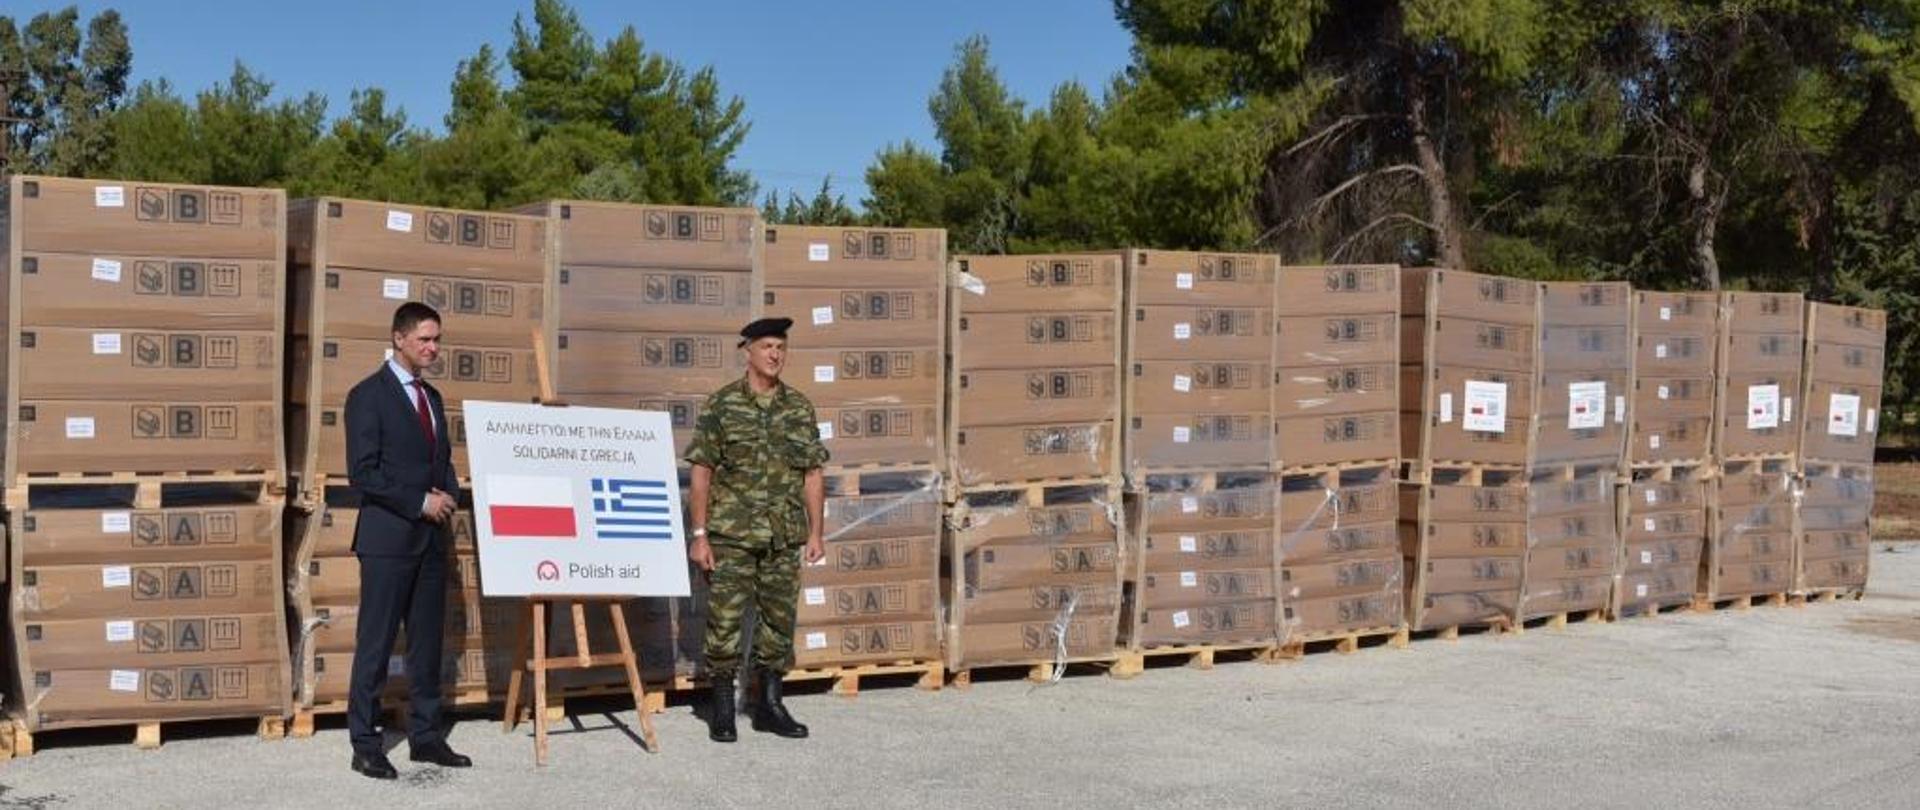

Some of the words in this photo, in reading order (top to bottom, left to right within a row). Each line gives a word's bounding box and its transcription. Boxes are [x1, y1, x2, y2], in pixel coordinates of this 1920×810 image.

[180, 194, 199, 218] B
[463, 220, 479, 242] B
[678, 216, 691, 236] B
[872, 236, 885, 255] B
[179, 267, 196, 291] B
[1054, 264, 1065, 282] B
[1222, 261, 1231, 278] B
[460, 287, 476, 308] B
[677, 279, 690, 299] B
[871, 296, 884, 314] B
[1054, 321, 1065, 338] B
[1221, 314, 1230, 331] B
[176, 339, 194, 362] B
[675, 342, 688, 362] B
[459, 355, 474, 376] B
[870, 356, 883, 374] B
[1054, 375, 1065, 393] B
[1218, 368, 1227, 384] B
[176, 410, 193, 433] B
[674, 406, 686, 424] B
[870, 414, 882, 432] B
[568, 425, 585, 439] ΜΕ
[587, 426, 612, 440] ΤΗΝ
[512, 444, 577, 460] SOLIDARNI
[580, 449, 589, 461] Z
[590, 449, 636, 465] GRECJĄ
[175, 518, 194, 541] A
[454, 520, 470, 540] A
[868, 546, 880, 564] A
[1078, 551, 1091, 569] A
[568, 562, 615, 579] Polish
[618, 563, 641, 579] aid
[175, 572, 194, 594] A
[865, 592, 878, 609] A
[180, 624, 199, 646] A
[869, 630, 884, 649] A
[187, 673, 207, 696] A
